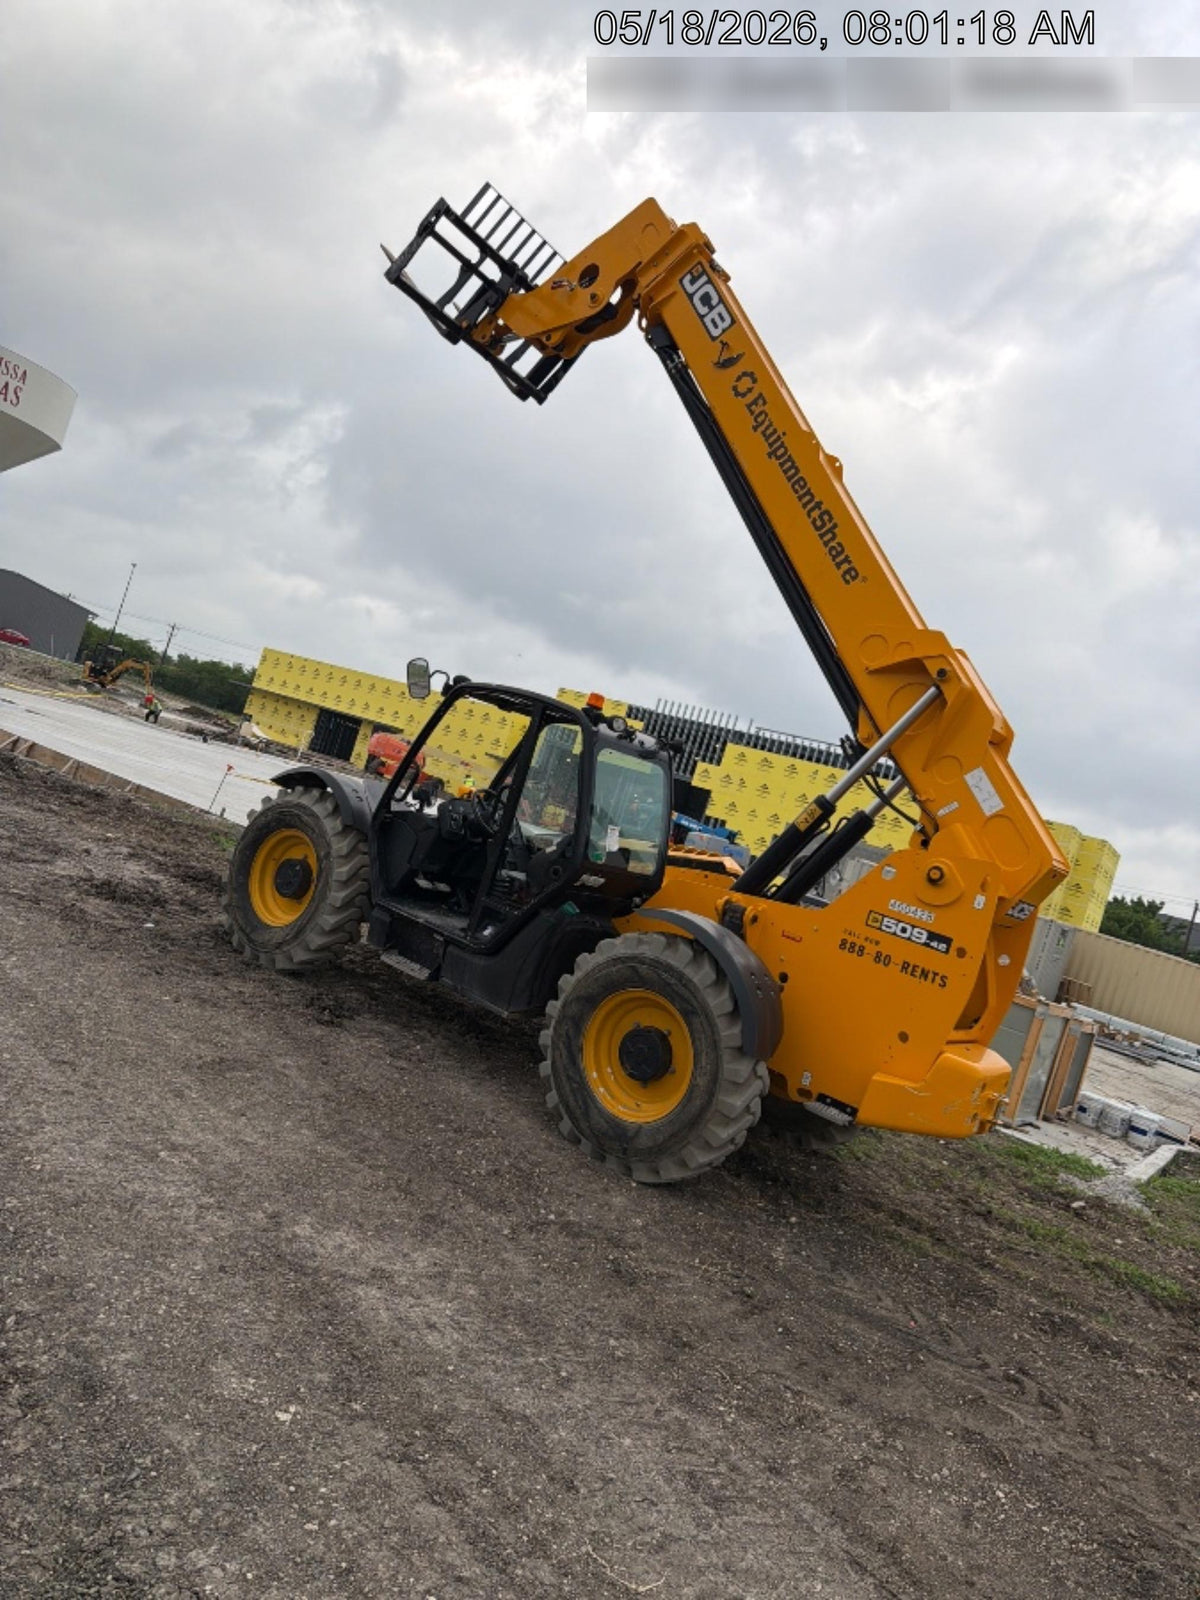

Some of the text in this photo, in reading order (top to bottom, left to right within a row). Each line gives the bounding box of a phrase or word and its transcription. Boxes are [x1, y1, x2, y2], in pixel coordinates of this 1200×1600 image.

[681, 269, 733, 339] JCB
[745, 391, 861, 586] EquipmentShare
[838, 938, 949, 989] 888-80-RENTS
